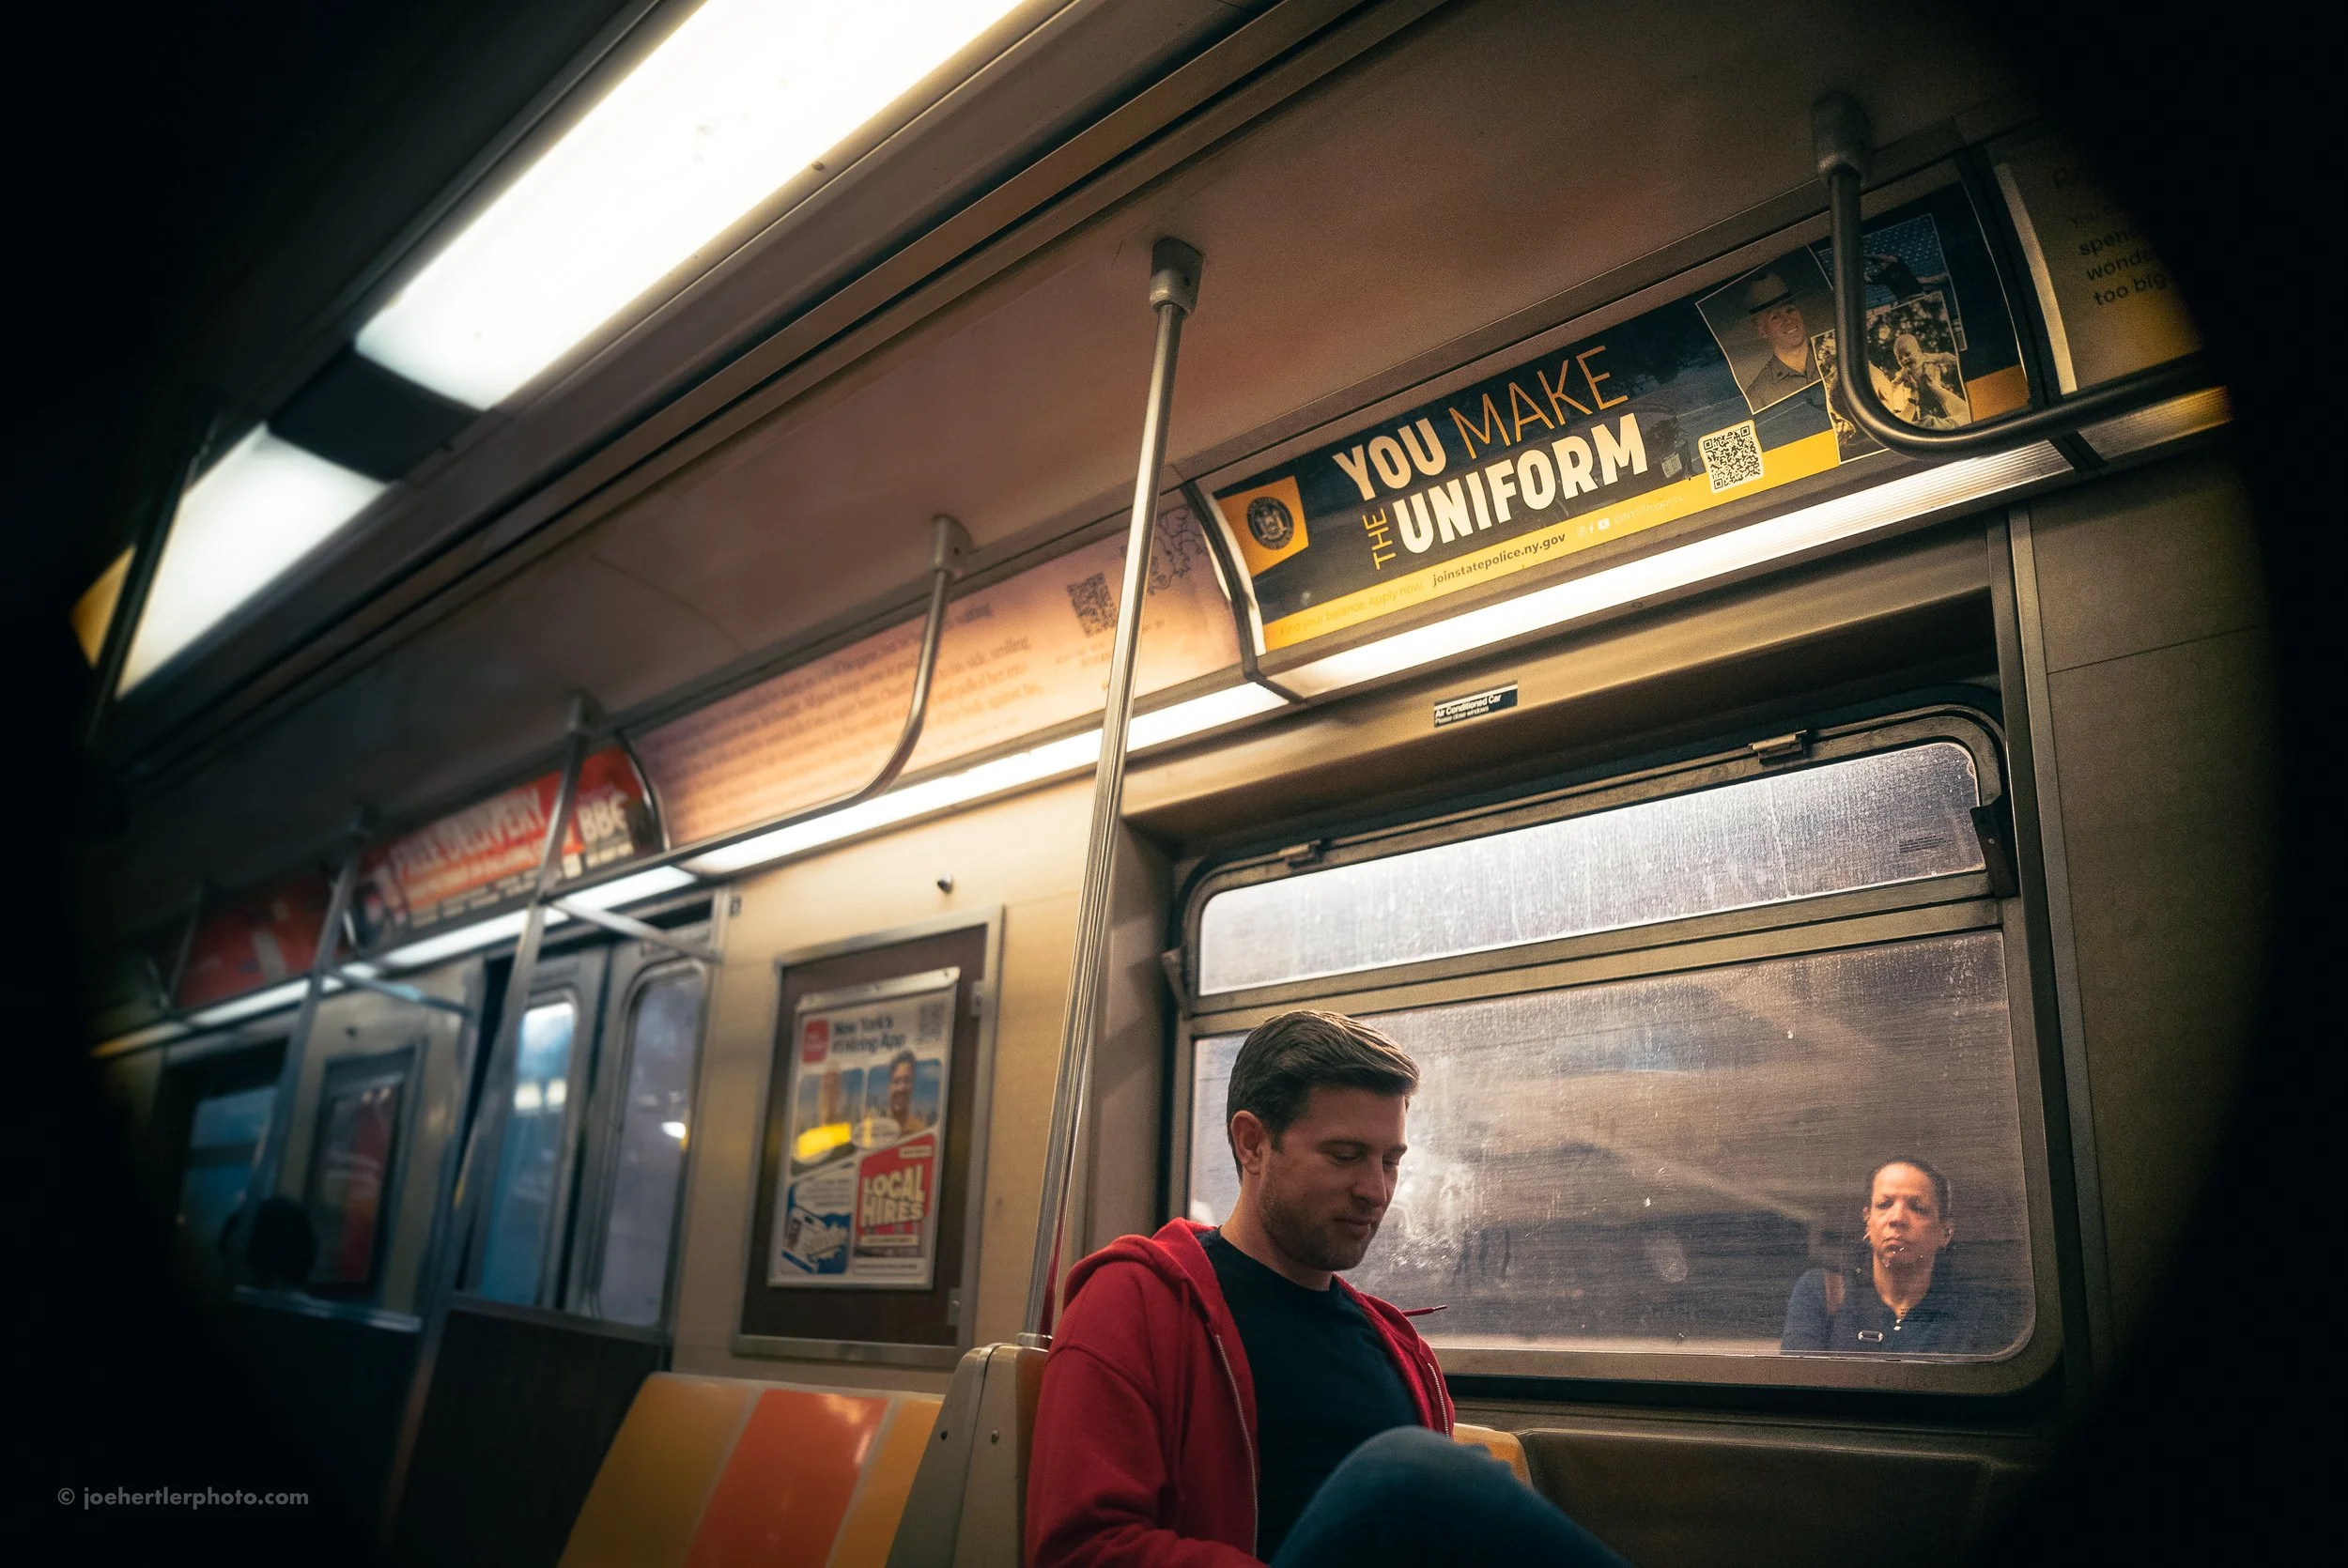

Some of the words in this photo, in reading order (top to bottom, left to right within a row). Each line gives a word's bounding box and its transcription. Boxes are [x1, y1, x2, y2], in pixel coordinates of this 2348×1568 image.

[2093, 285, 2130, 306] too
[2133, 271, 2168, 294] big
[1332, 417, 1447, 502] YOU
[1448, 345, 1630, 460] MAKE
[1392, 412, 1649, 555] UNIFORM
[1362, 507, 1398, 571] THE
[1368, 591, 1398, 608] Apply
[1431, 531, 1567, 587] joinstatepolice.ny.gov
[1435, 709, 1445, 718] Air
[1445, 698, 1489, 715] Conditioned
[1488, 694, 1502, 705] Car
[833, 1022, 857, 1035] New
[862, 1164, 926, 1203] LOCAL
[858, 1193, 924, 1228] HIRES
